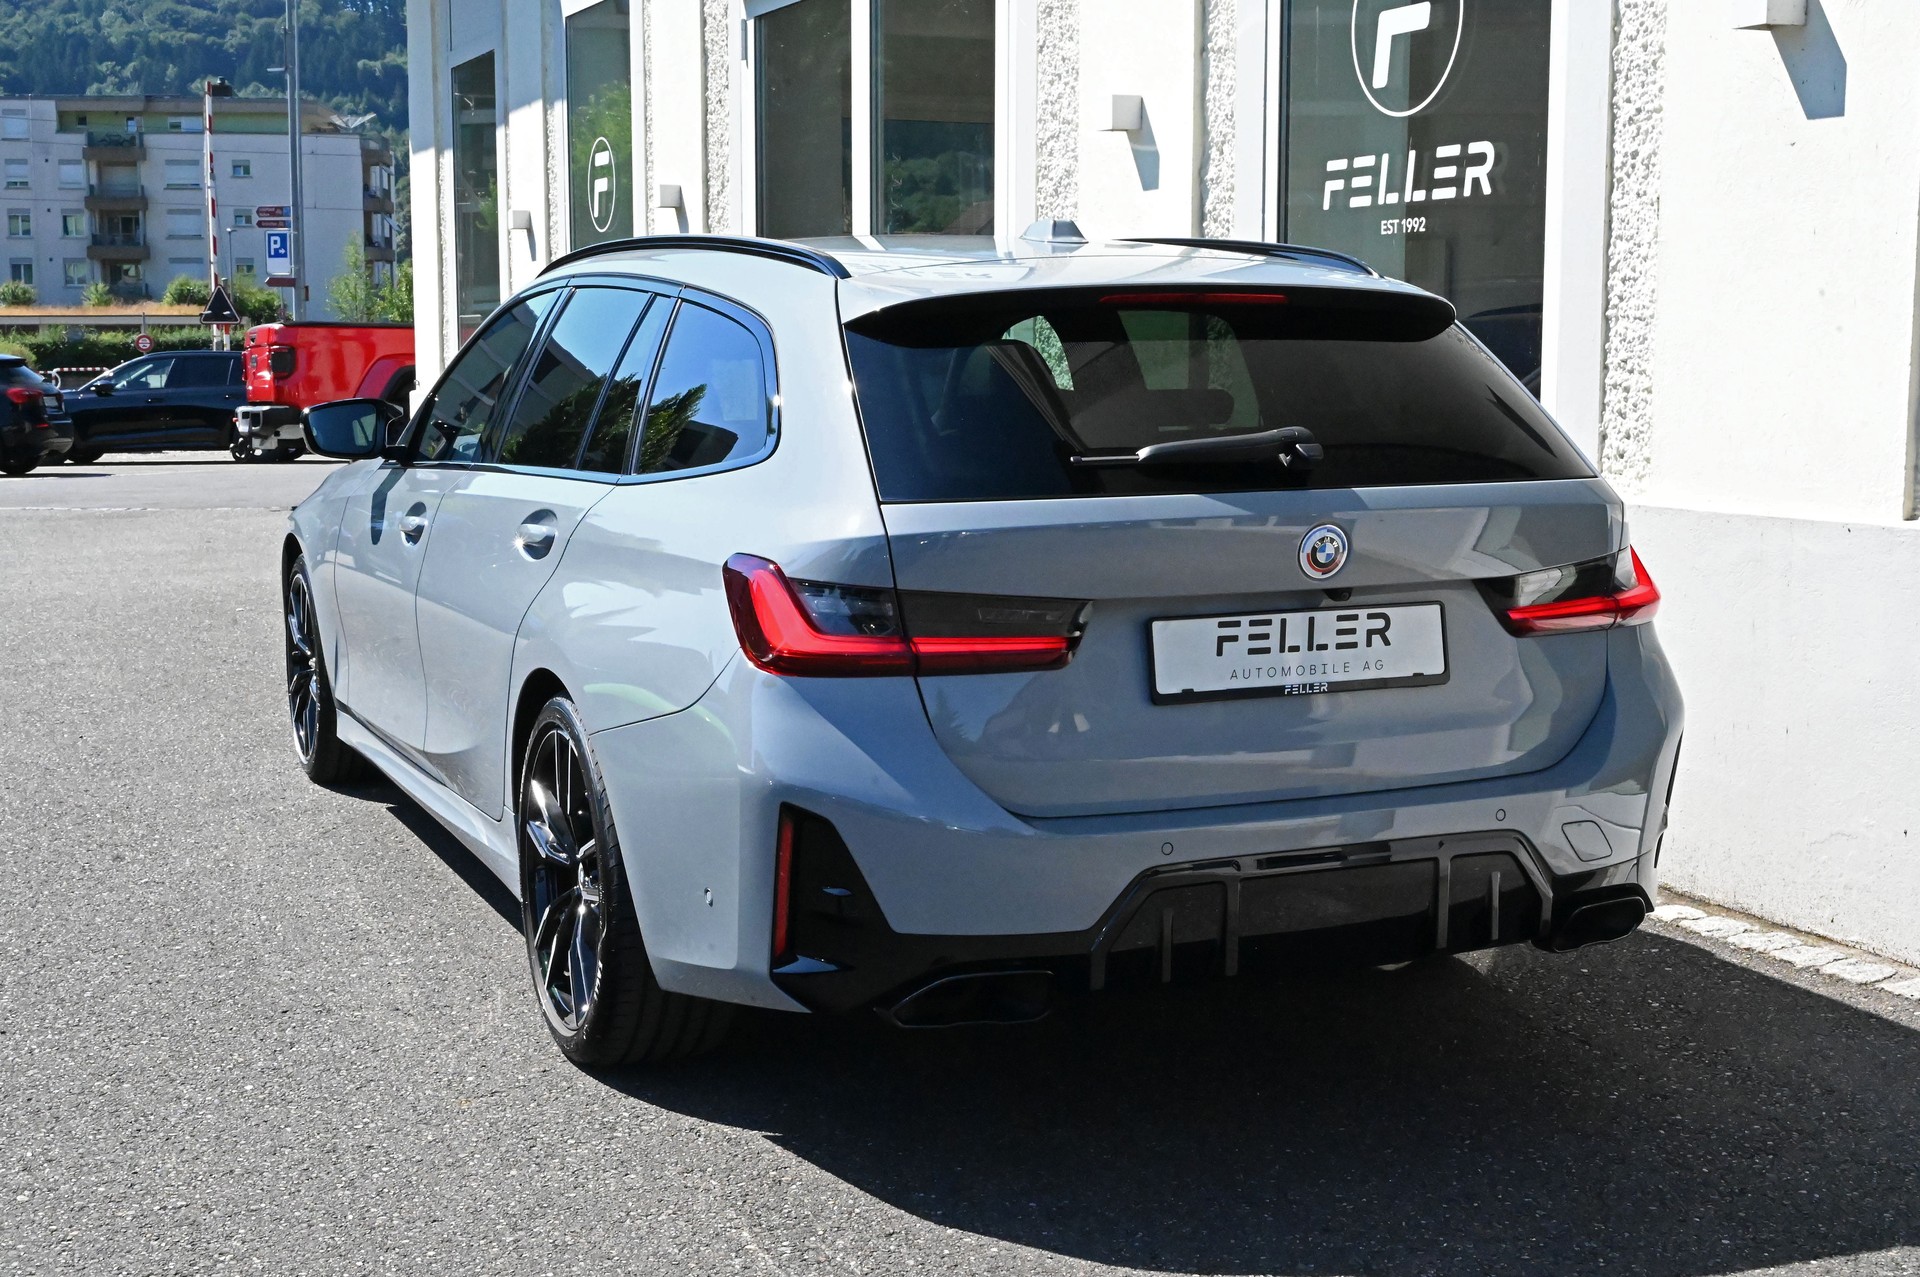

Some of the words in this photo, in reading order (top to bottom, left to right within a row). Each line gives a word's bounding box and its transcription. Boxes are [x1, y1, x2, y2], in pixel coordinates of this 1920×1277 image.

[1323, 140, 1495, 210] FELLER
[1380, 219, 1399, 235] EST
[1401, 216, 1426, 234] 1992
[270, 235, 281, 256] P
[1216, 612, 1391, 657] FELLER
[1230, 661, 1351, 680] AUTOMOBILE
[1362, 659, 1385, 672] AG
[1284, 682, 1328, 695] FELLER
